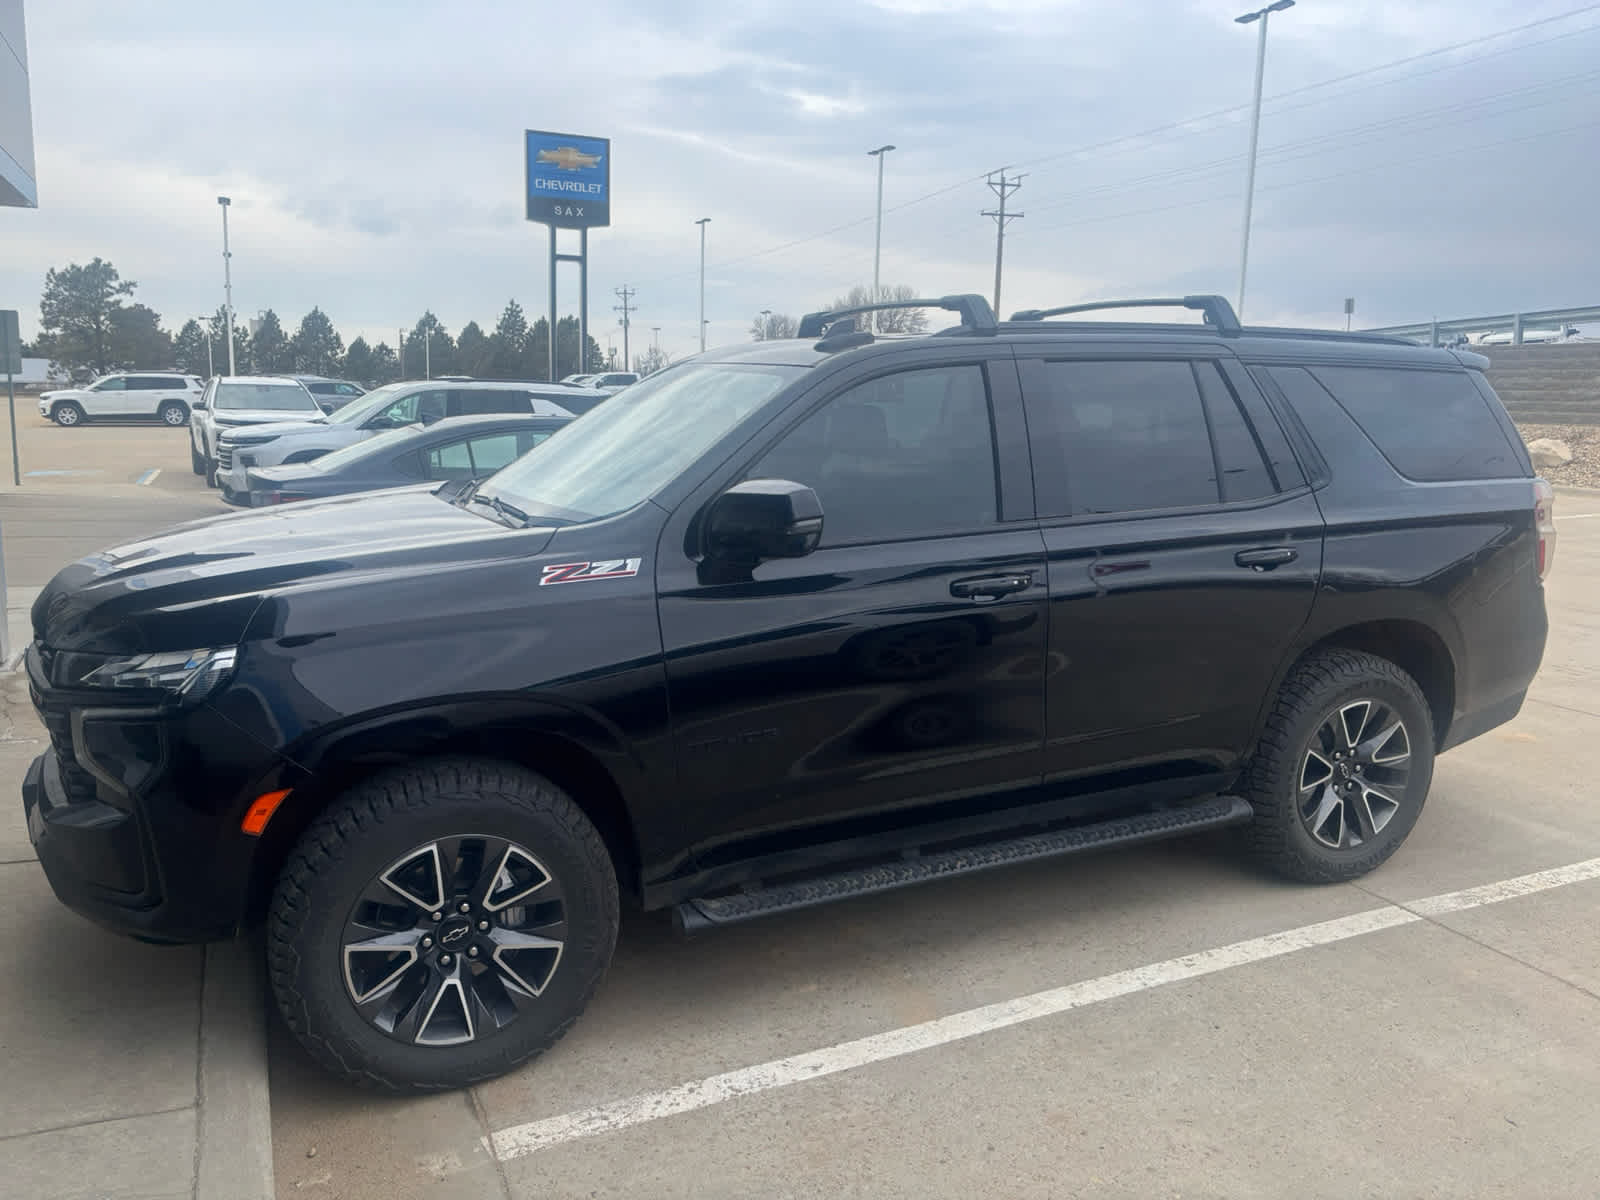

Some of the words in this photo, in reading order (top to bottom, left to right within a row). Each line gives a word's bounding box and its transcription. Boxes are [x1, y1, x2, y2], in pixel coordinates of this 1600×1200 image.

[535, 178, 602, 194] CHEVROLET
[554, 205, 584, 217] SAX
[539, 557, 642, 586] Z71
